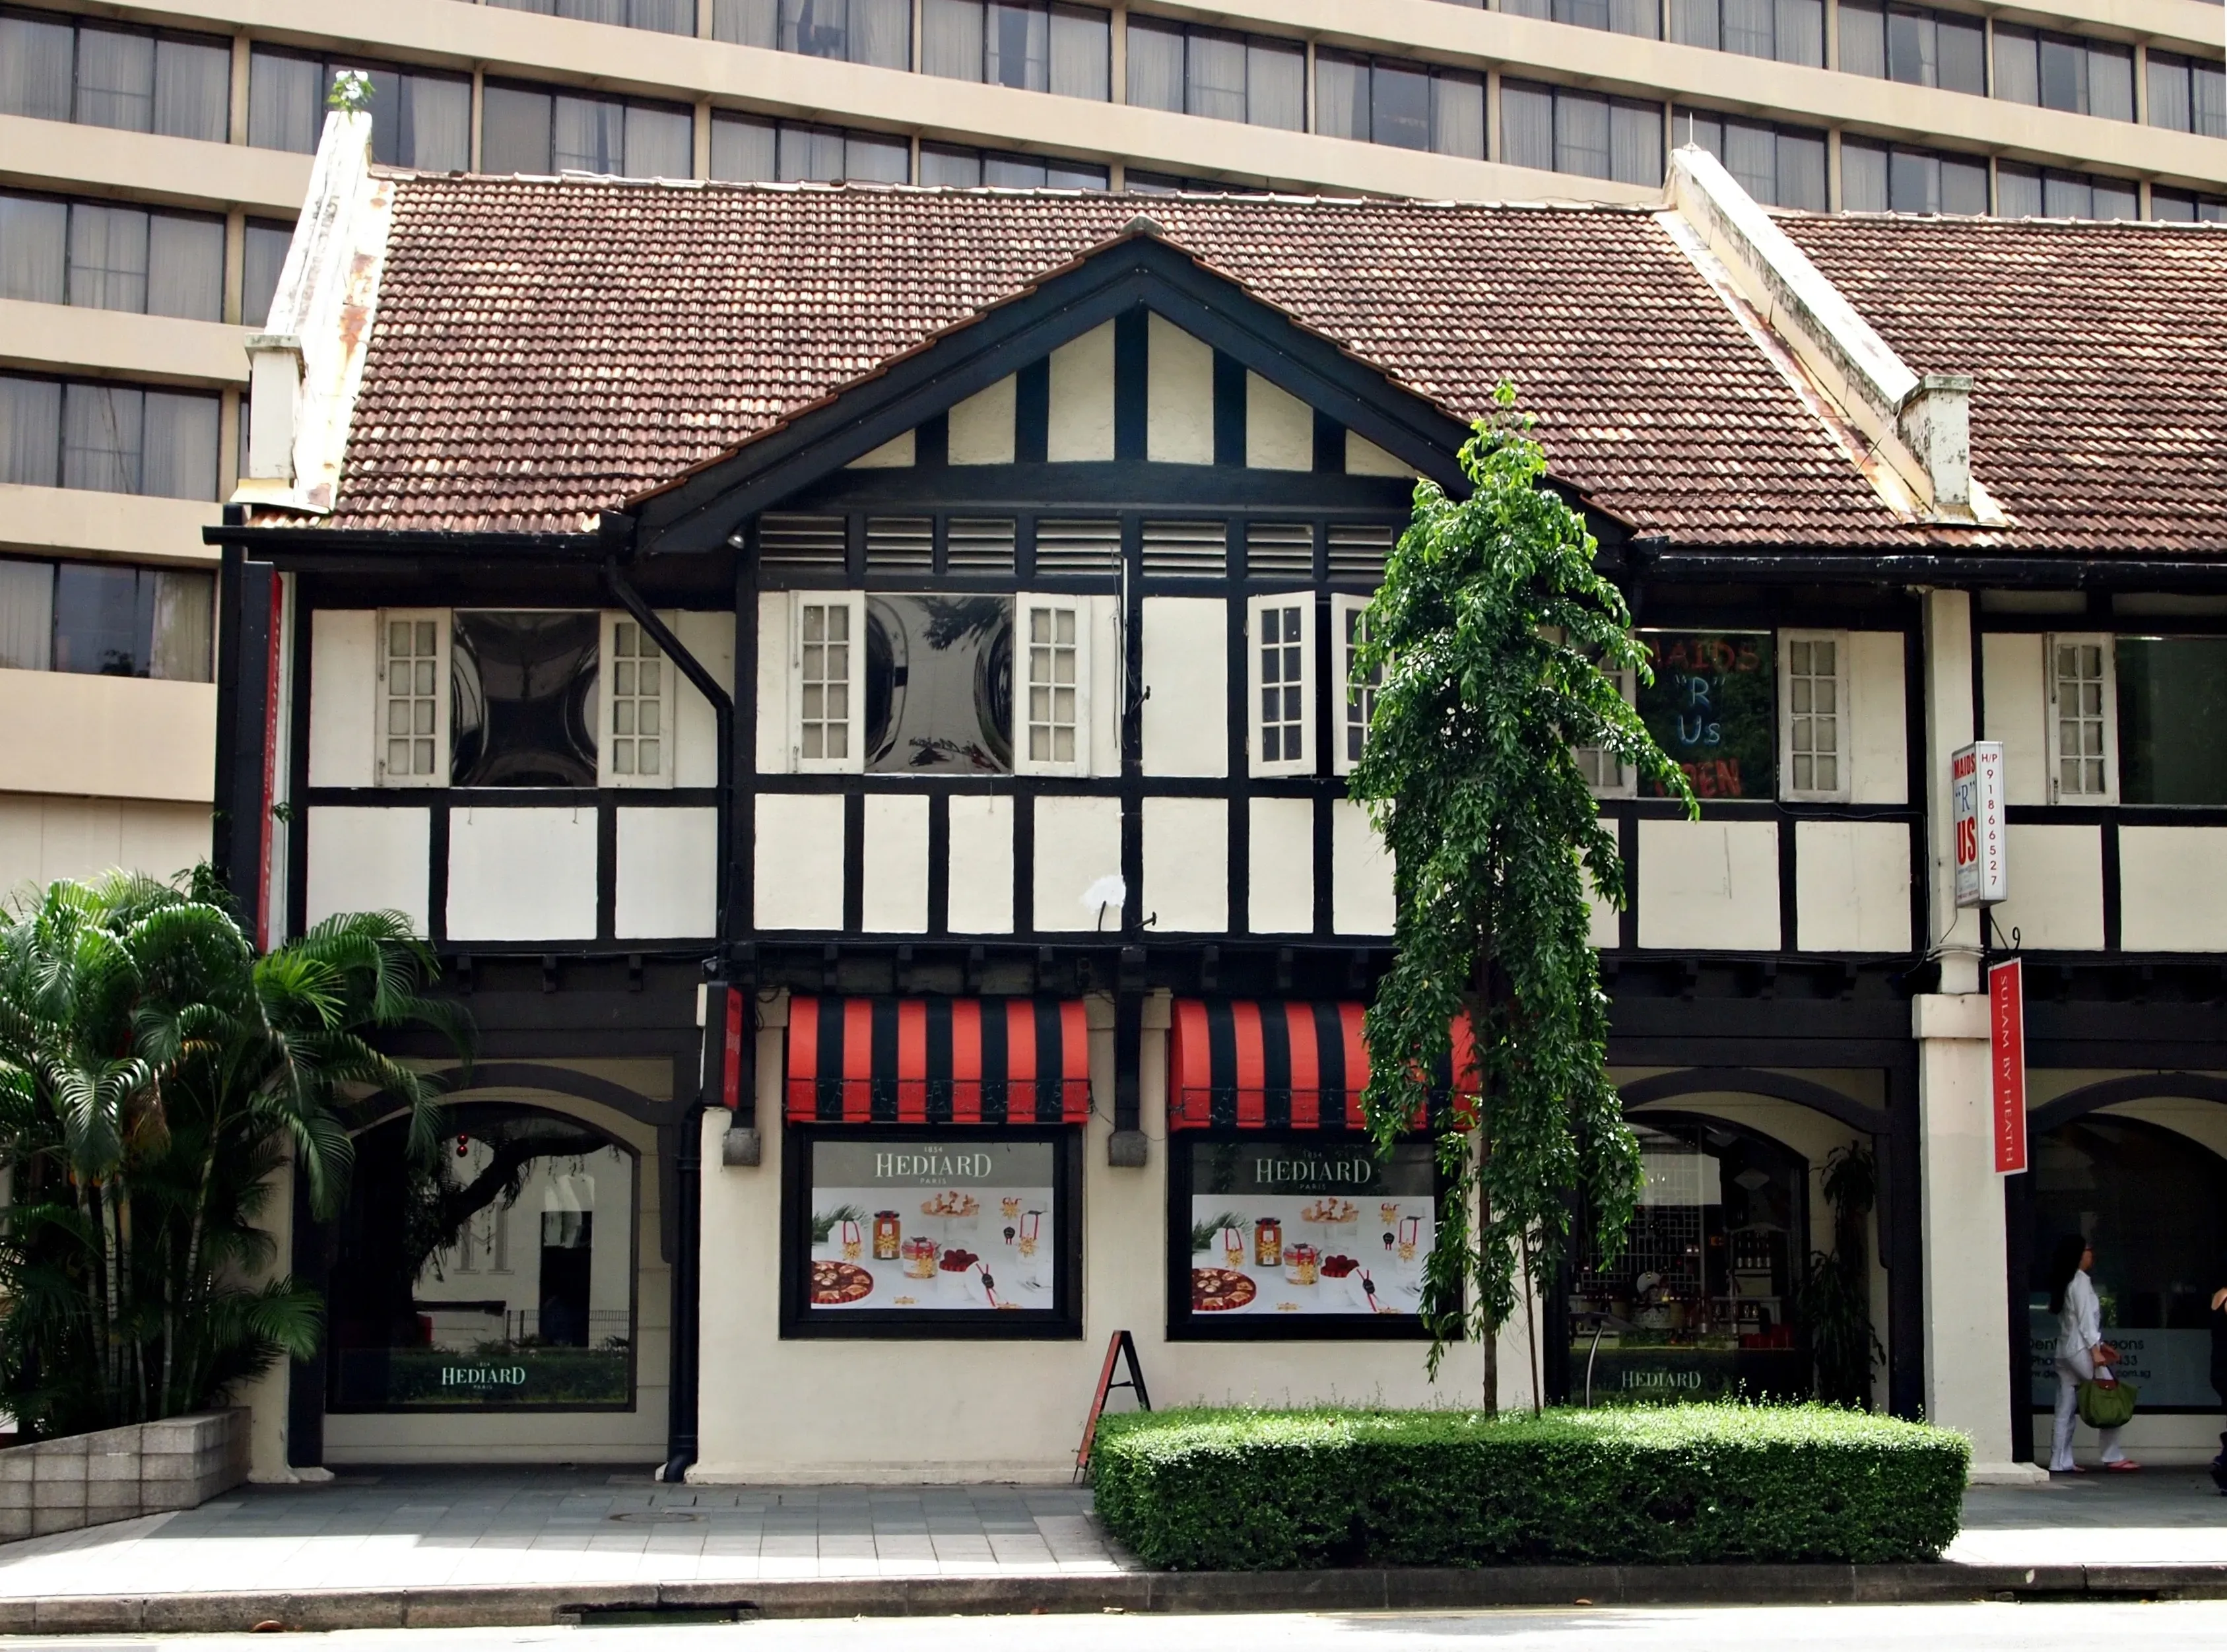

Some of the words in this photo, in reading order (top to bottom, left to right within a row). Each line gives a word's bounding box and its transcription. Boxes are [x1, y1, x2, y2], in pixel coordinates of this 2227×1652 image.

[1954, 752, 1975, 780] MAIDS
[1981, 754, 1997, 762] H/P
[1957, 816, 1976, 865] US
[2001, 975, 2009, 1048] SULAM
[2003, 1057, 2011, 1080] BY
[2004, 1090, 2013, 1162] HEATH
[875, 1153, 991, 1177] HEDIARD
[1255, 1158, 1371, 1183] HEDIARD
[442, 1366, 526, 1385] HEDIARD
[1622, 1370, 1702, 1389] HEDIARD
